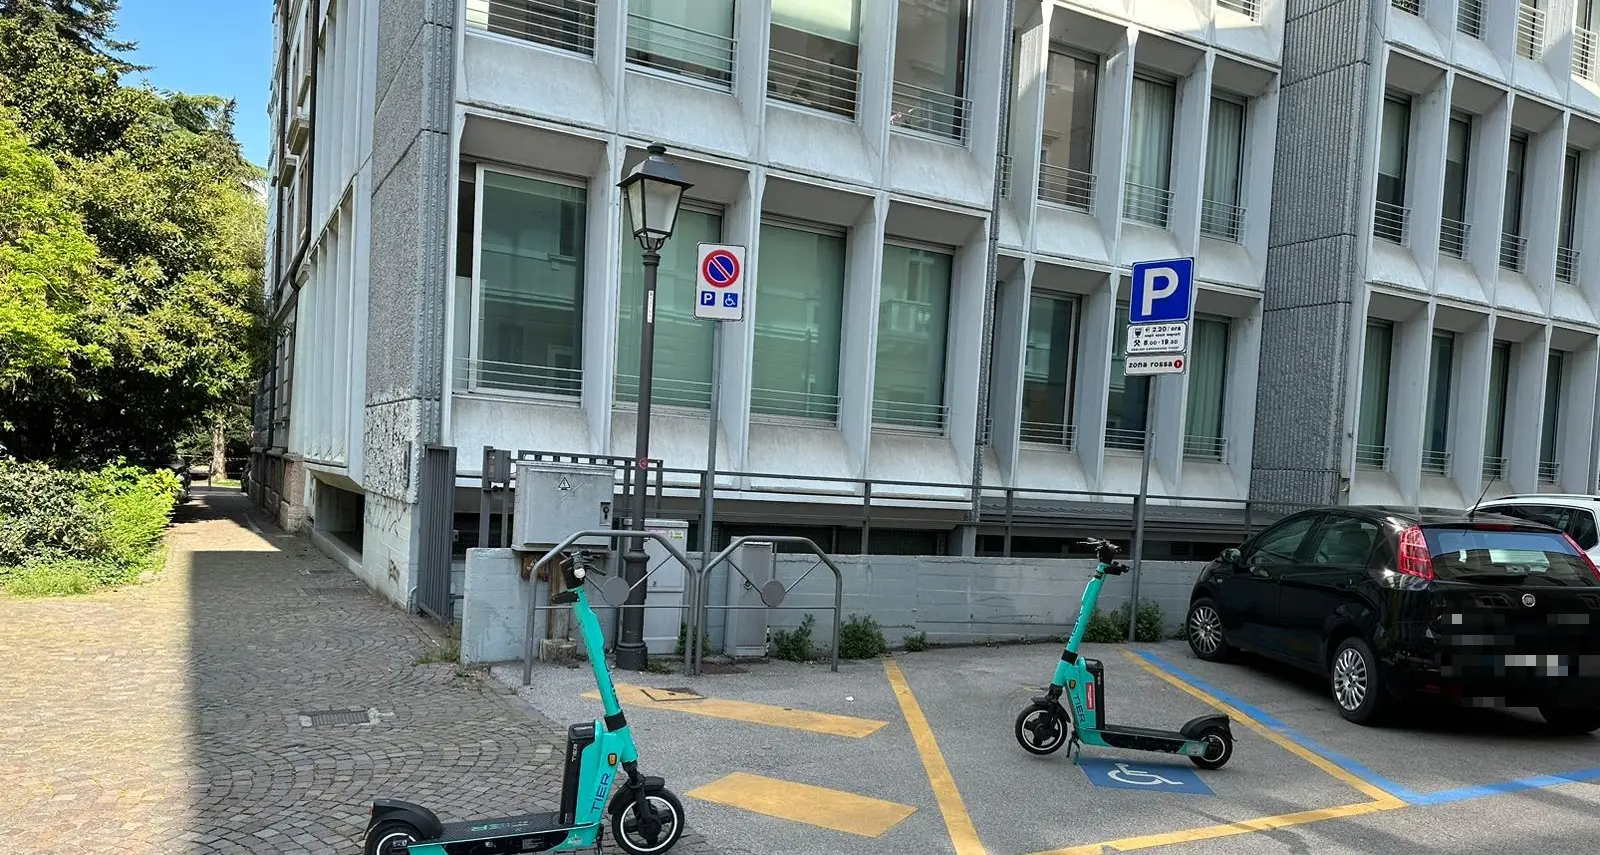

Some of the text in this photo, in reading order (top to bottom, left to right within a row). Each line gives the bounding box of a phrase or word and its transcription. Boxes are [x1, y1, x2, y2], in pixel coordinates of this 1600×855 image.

[704, 293, 713, 304] P
[1141, 267, 1179, 316] P
[1073, 693, 1085, 722] TIER
[591, 773, 610, 813] TIER
